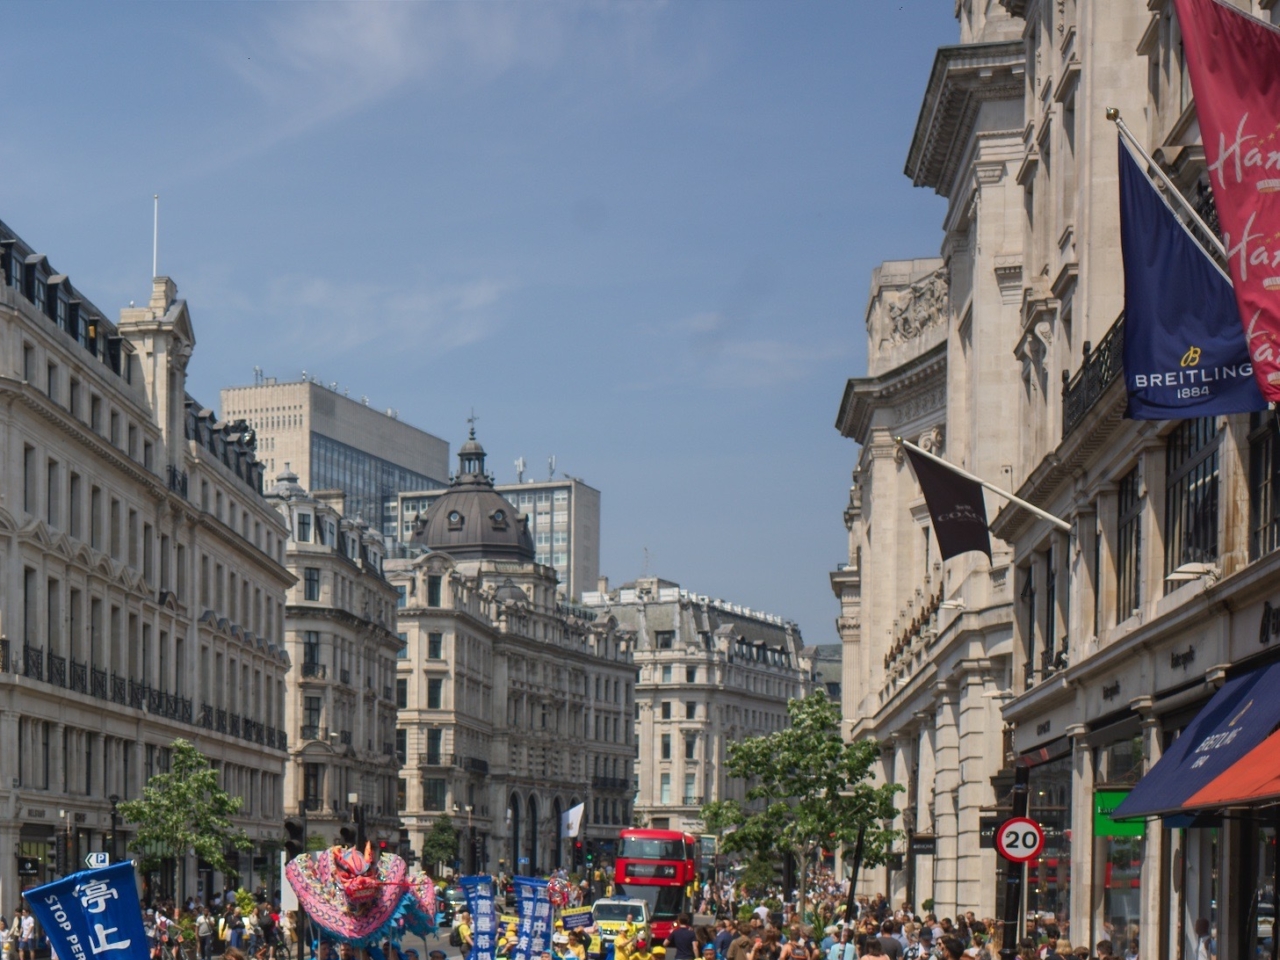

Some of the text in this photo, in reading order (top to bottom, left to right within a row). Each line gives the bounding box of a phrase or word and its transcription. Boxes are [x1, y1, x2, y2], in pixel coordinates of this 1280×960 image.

[1135, 363, 1254, 388] BREITLING
[1177, 386, 1210, 399] 1884
[1005, 830, 1038, 849] 20
[44, 894, 72, 932] STOP
